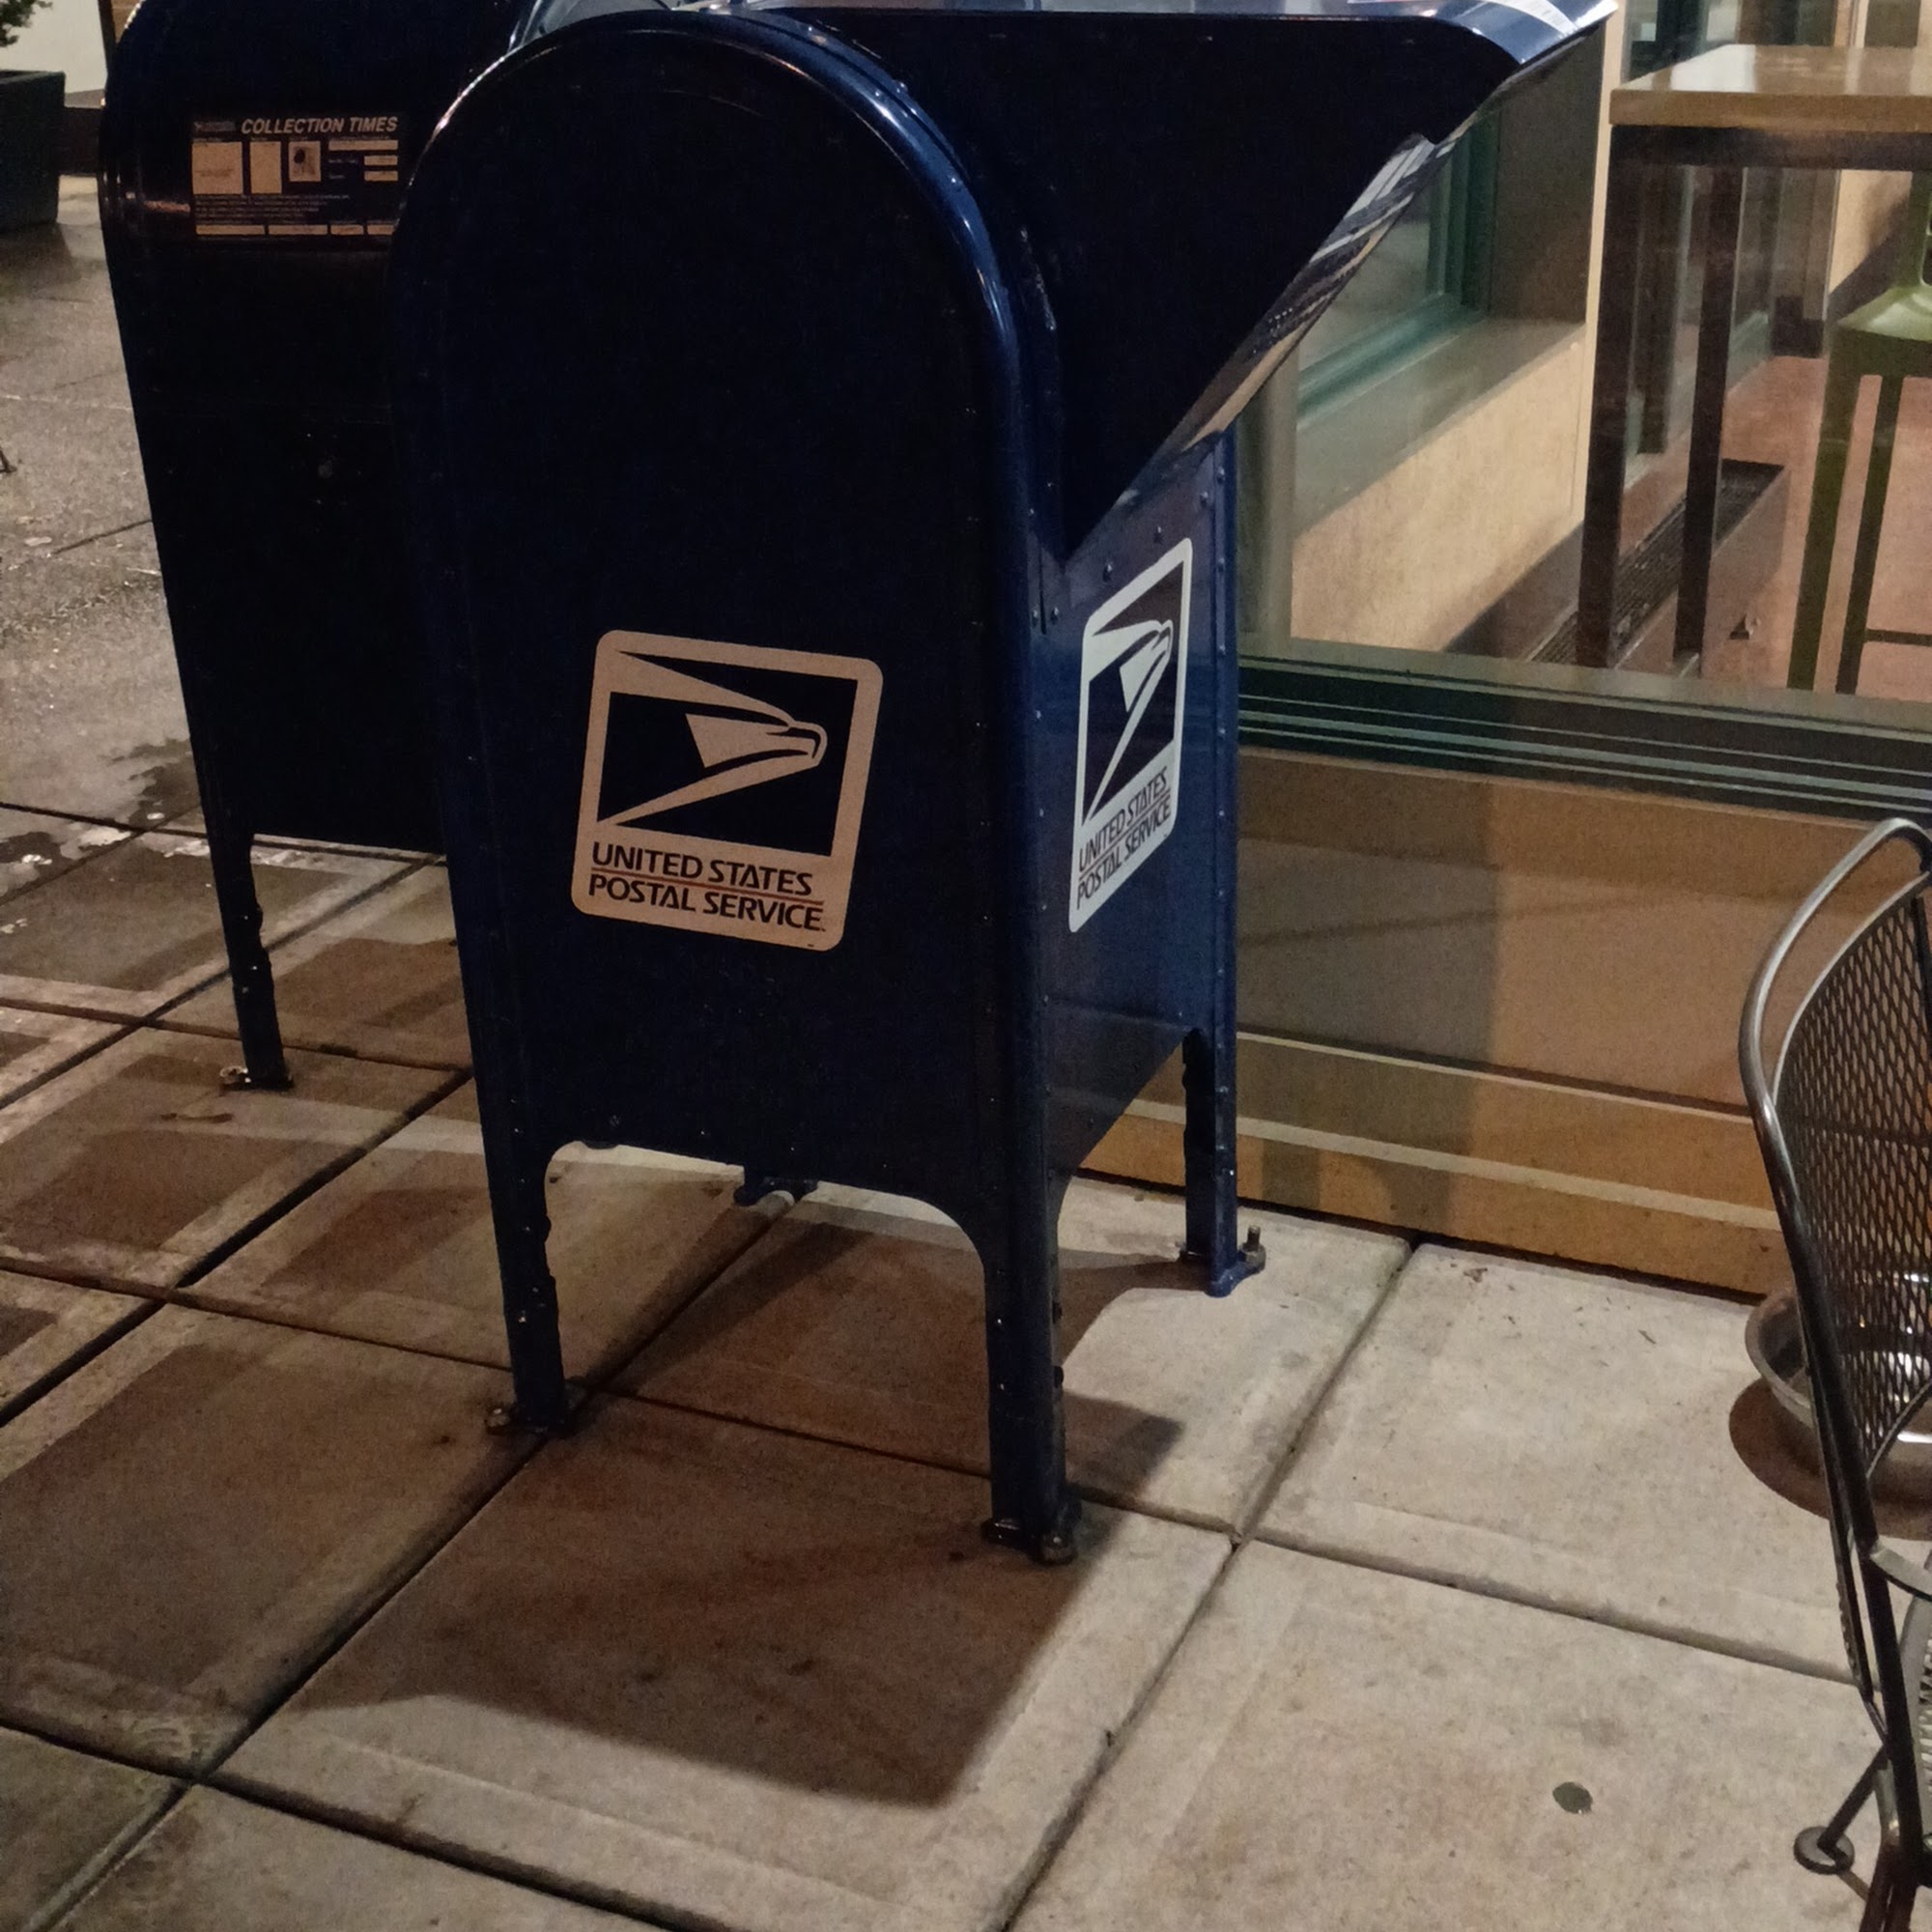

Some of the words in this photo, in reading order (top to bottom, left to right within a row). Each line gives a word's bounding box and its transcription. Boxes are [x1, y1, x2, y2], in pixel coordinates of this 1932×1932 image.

[242, 118, 345, 134] COLLECTION
[350, 116, 398, 132] TIMES
[1079, 809, 1124, 872] UNITED
[1127, 766, 1168, 826] STATES
[592, 841, 703, 879] UNITED
[708, 859, 813, 896] STATES
[1076, 846, 1122, 910] POSTAL
[1124, 794, 1172, 861] SERVICE
[588, 873, 696, 912] POSTAL
[702, 891, 824, 931] SERVICE
